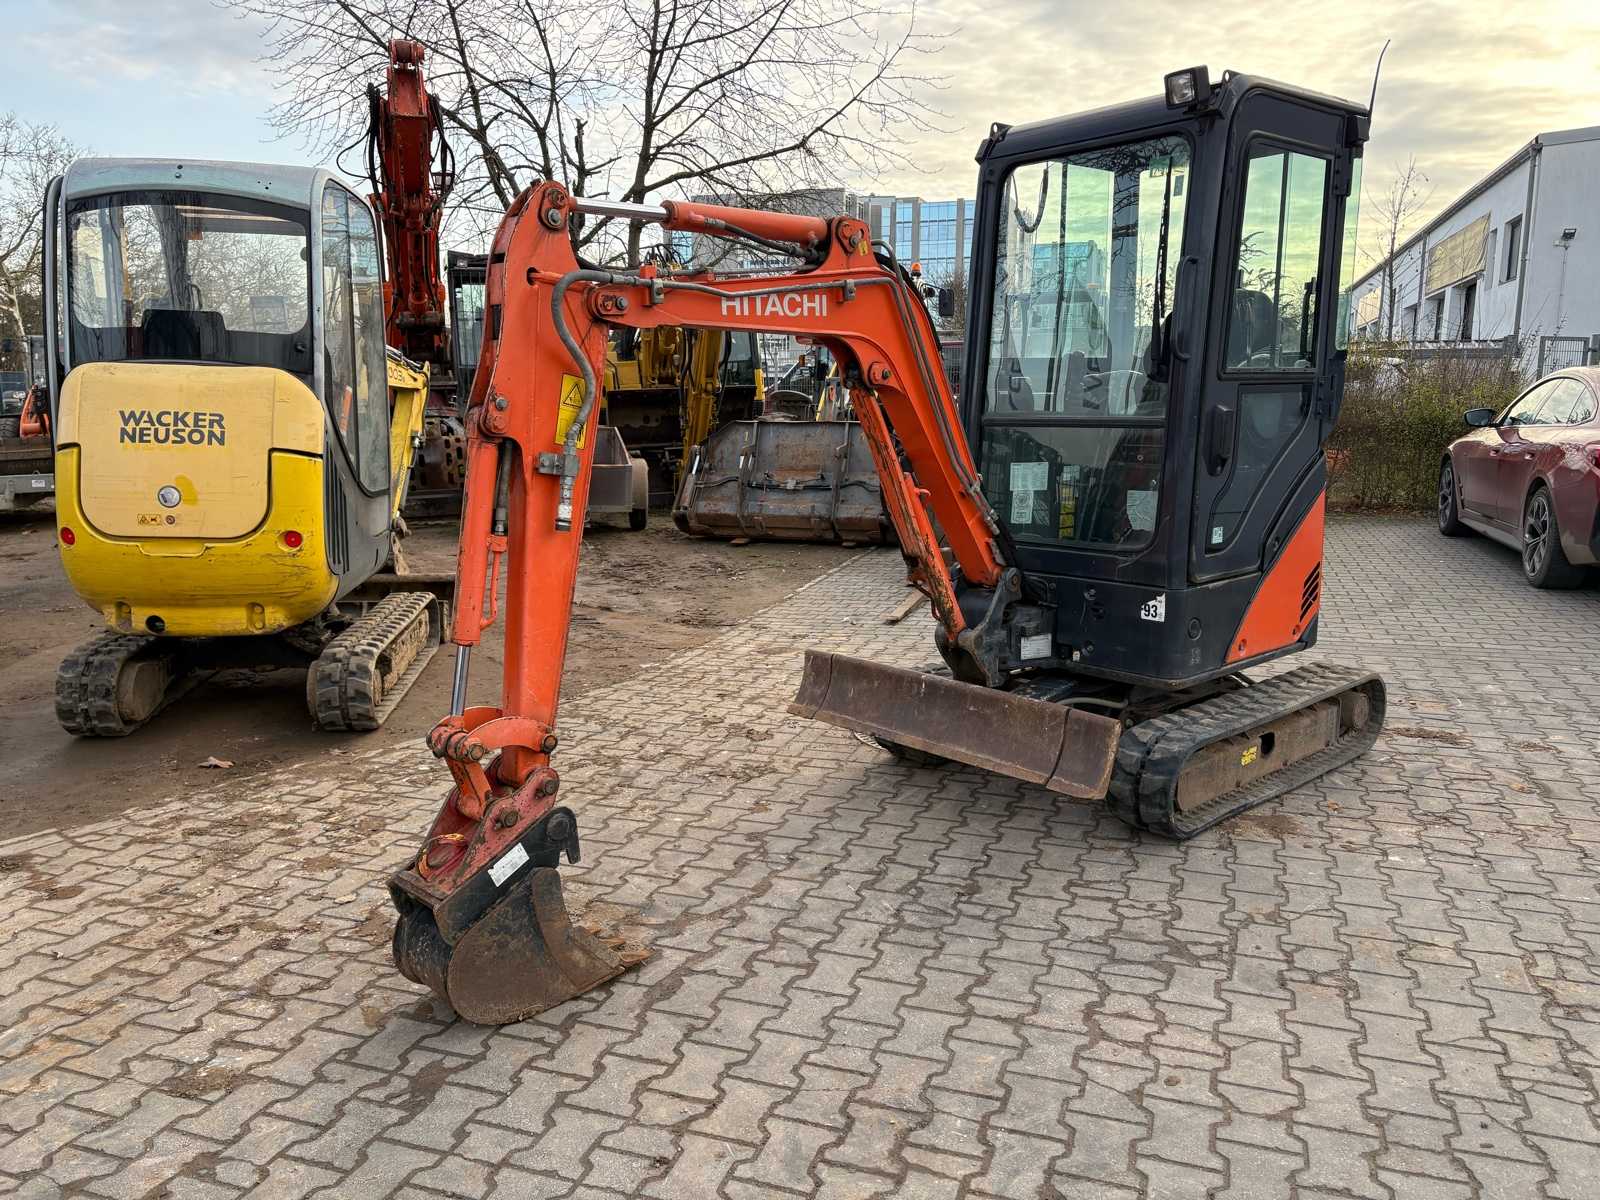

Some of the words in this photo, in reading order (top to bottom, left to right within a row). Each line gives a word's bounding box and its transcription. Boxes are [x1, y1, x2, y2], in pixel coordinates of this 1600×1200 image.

[721, 293, 828, 317] HITACHI
[119, 410, 226, 430] WACKER
[119, 427, 226, 447] NEUSON
